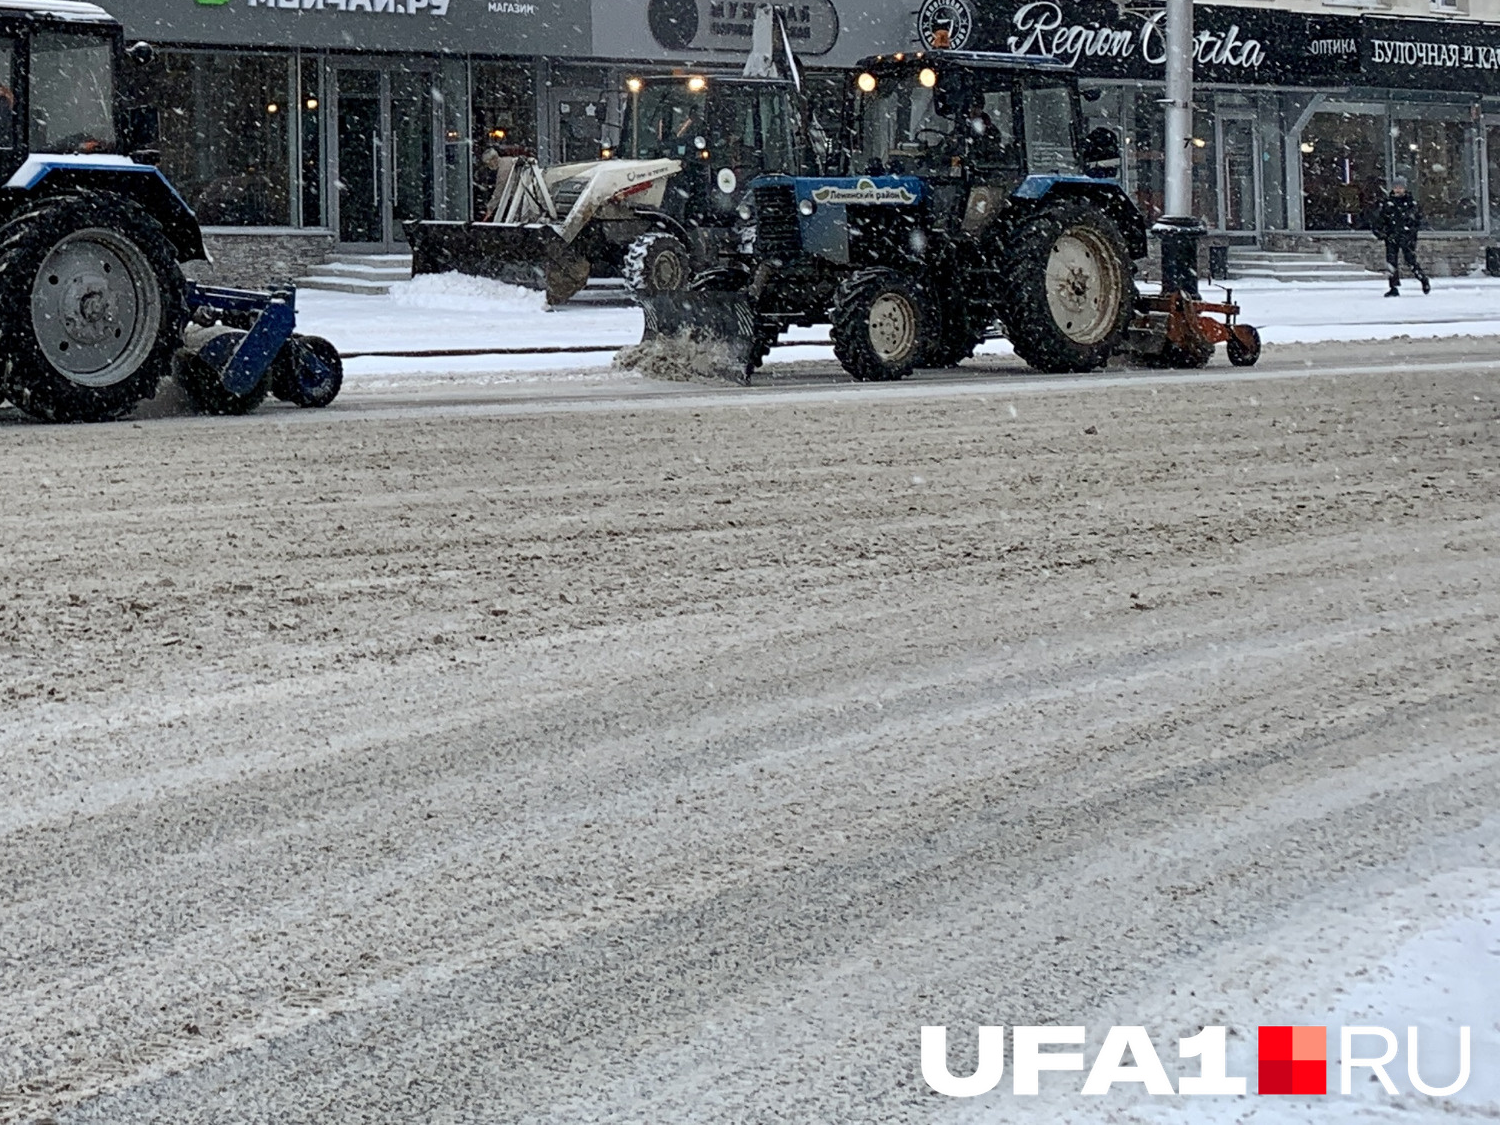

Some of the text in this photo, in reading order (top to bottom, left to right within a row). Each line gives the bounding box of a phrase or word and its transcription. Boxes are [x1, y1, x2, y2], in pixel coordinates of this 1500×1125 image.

[488, 1, 534, 15] МАГАЗИН
[1007, 1, 1135, 68] Region
[1140, 11, 1265, 68] Otika
[1311, 38, 1357, 55] ОПТИКА
[1371, 39, 1459, 68] БУЛОЧНАЯ
[1475, 46, 1500, 69] КА
